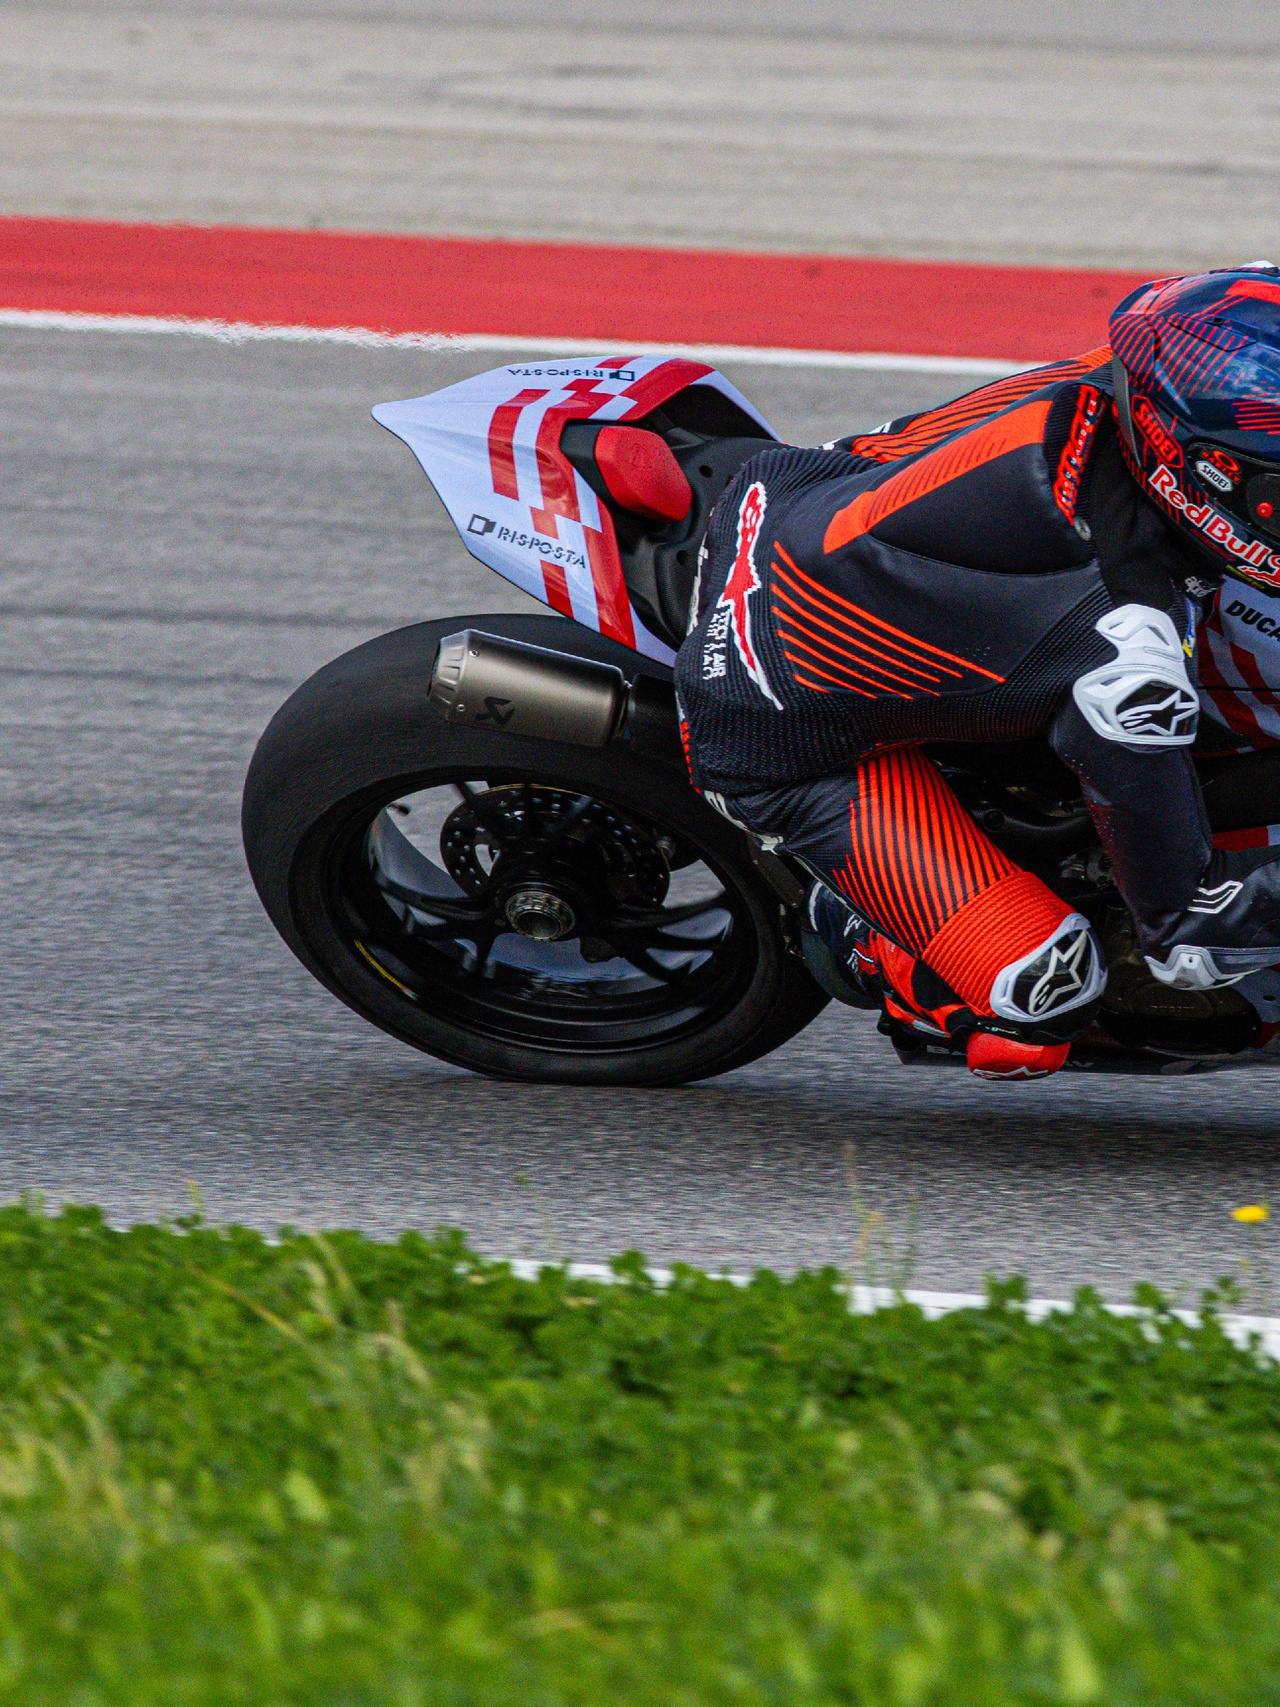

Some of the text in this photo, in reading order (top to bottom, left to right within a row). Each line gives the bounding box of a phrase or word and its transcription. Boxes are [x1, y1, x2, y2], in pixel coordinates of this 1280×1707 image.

[1136, 403, 1179, 462] SHOEI
[1201, 464, 1228, 489] SHOEI
[1148, 464, 1214, 527] Red
[1203, 514, 1273, 567] Bull
